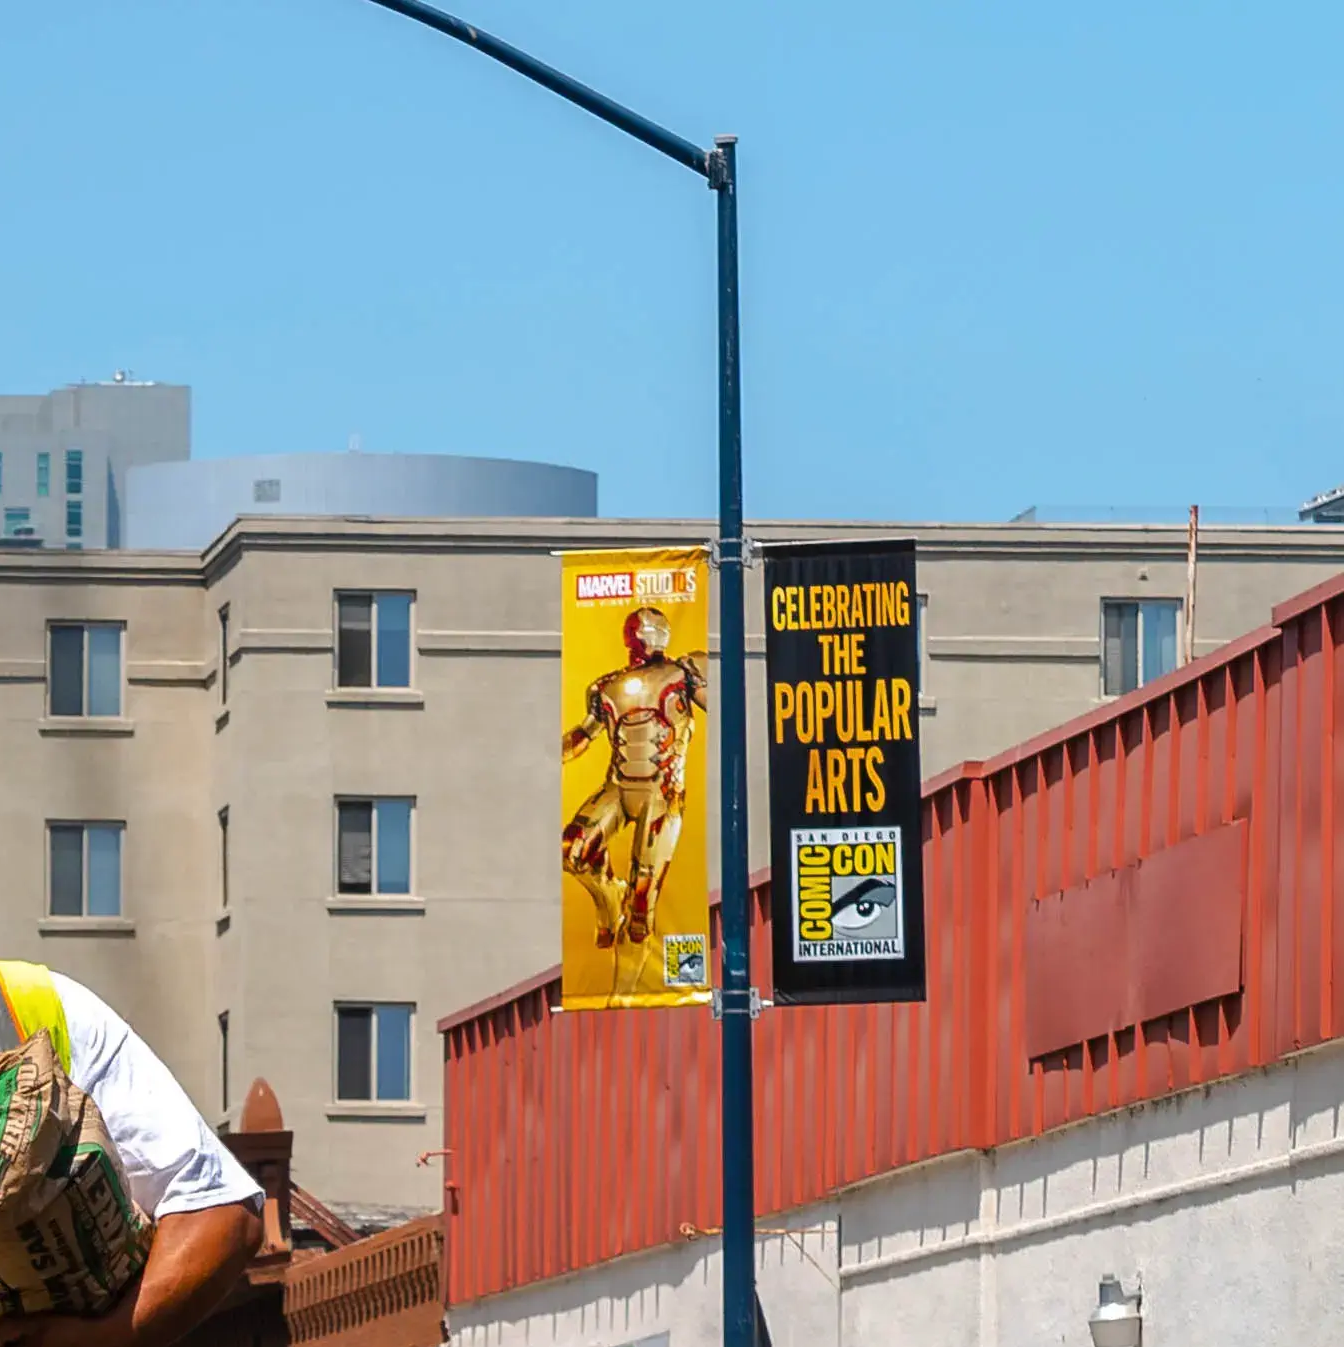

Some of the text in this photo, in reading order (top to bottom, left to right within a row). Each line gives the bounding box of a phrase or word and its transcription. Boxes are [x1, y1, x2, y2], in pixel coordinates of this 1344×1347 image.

[577, 574, 632, 598] MARVEL
[772, 581, 910, 631] CELEBRATING
[818, 633, 867, 675] THE
[774, 678, 913, 744] POPULAR
[805, 746, 886, 814] ARTS
[796, 831, 896, 843] SAN DIEGO
[832, 843, 896, 875] CON
[799, 845, 832, 940] COMIC
